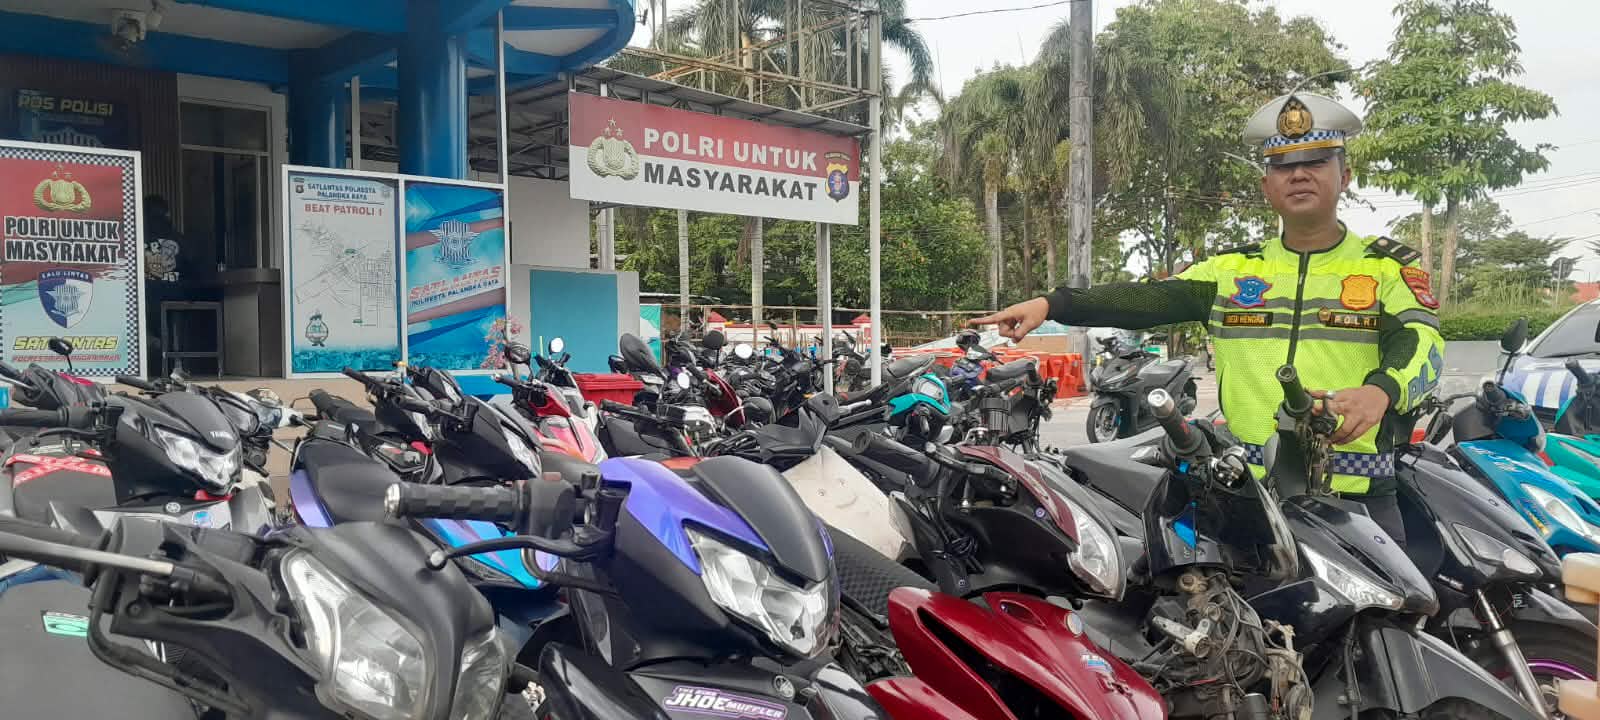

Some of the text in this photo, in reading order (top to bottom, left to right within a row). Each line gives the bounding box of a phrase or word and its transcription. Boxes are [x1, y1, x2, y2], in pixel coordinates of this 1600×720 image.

[60, 98, 113, 116] POLISI
[644, 128, 817, 171] POLRI UNTUK
[644, 162, 817, 200] MASYARAKAT
[304, 203, 331, 213] BEAT
[334, 205, 375, 216] PATROLI
[4, 216, 120, 241] POLRI UNTUK
[5, 239, 120, 264] MASYRAKAT
[14, 335, 118, 350] SATNTAS
[665, 692, 784, 718] JHOE MUFFLER
